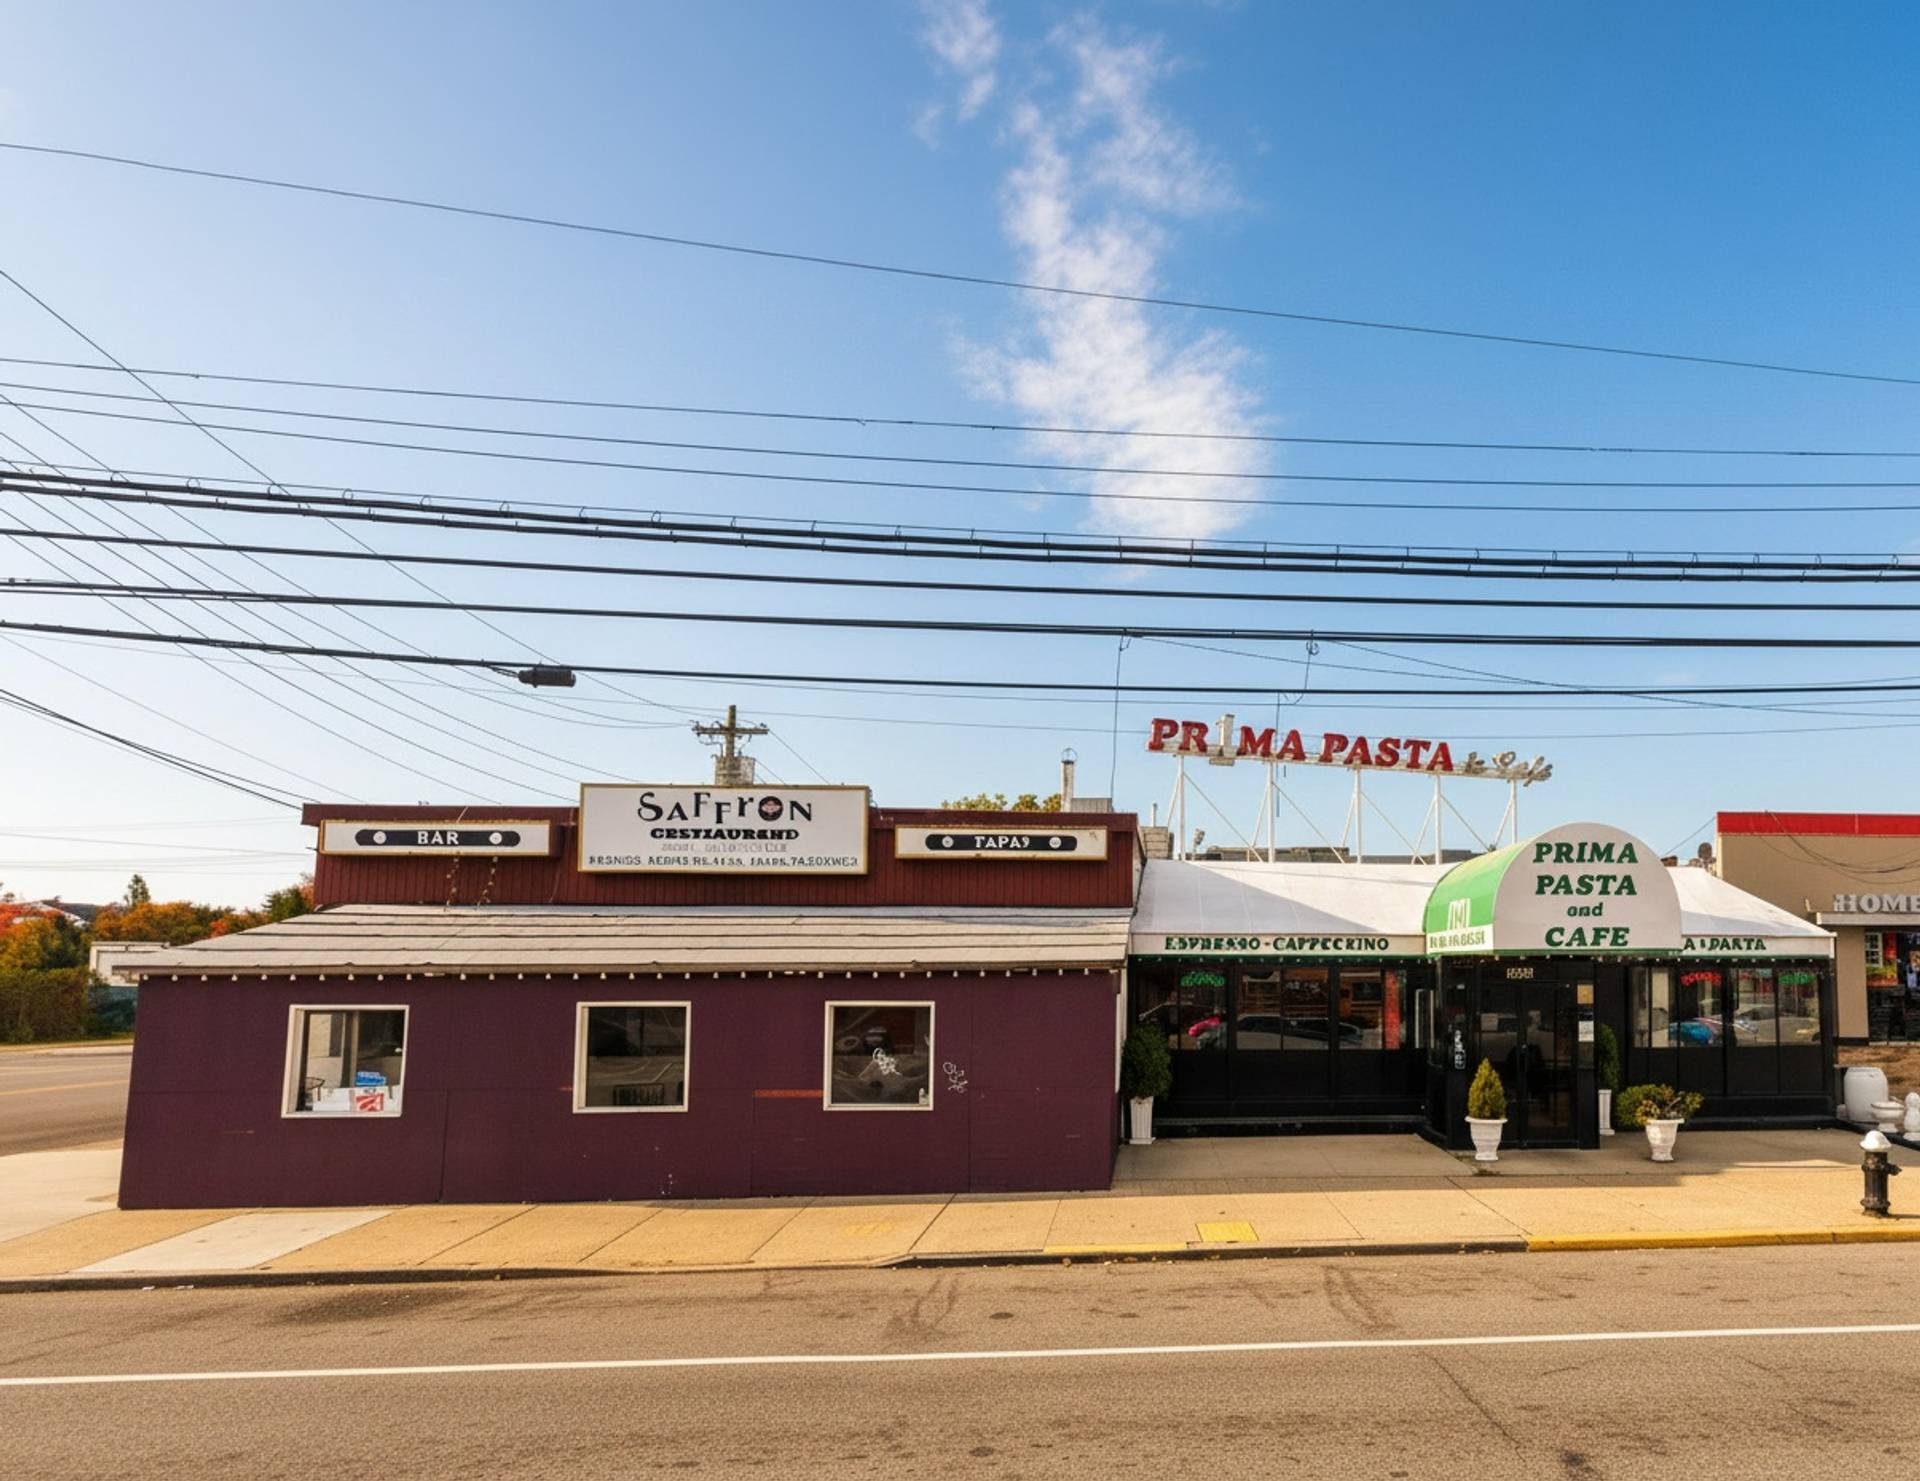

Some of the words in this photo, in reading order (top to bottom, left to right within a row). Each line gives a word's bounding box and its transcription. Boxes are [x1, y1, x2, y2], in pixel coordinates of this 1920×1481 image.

[1148, 714, 1306, 766] PRIMA
[1318, 732, 1454, 772] PASTA
[417, 831, 459, 845] BAR
[1533, 842, 1639, 863] PRIMA
[1535, 875, 1637, 895] PASTA
[1567, 902, 1603, 917] and
[1545, 927, 1630, 947] CAFE
